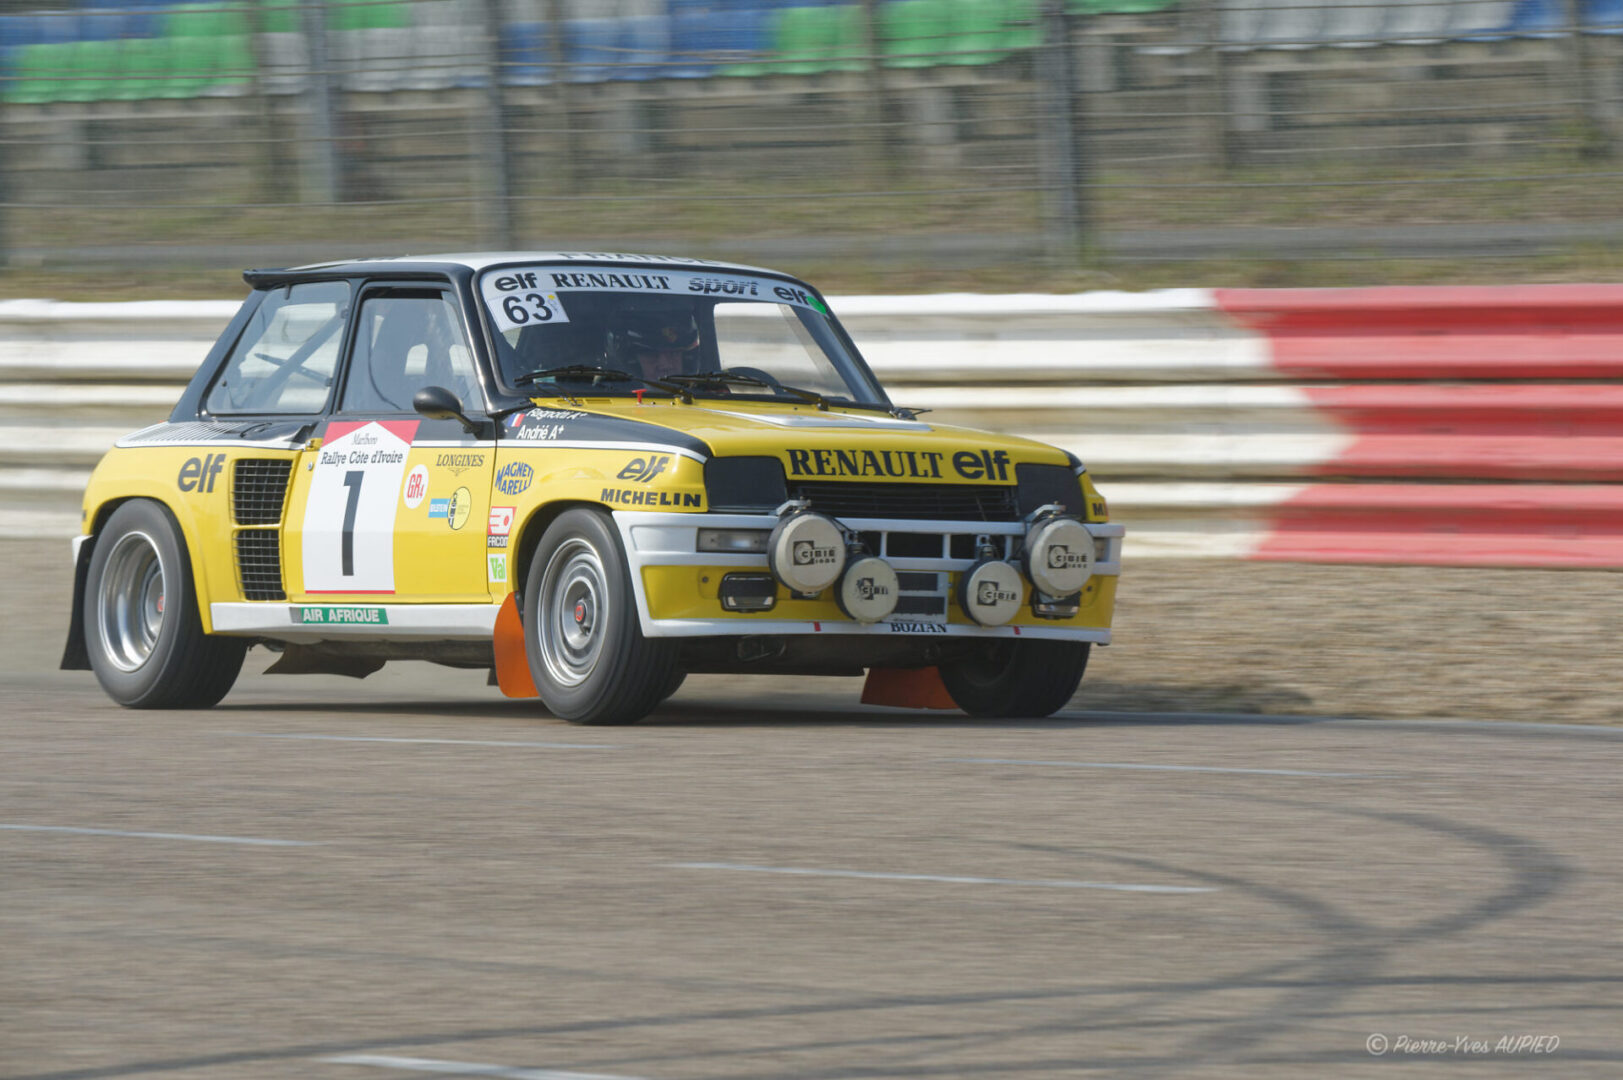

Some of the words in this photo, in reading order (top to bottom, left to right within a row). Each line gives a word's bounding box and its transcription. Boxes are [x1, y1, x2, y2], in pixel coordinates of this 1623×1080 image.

[494, 272, 538, 292] elf
[549, 272, 672, 290] RENAULT
[688, 277, 760, 296] sport
[773, 286, 809, 306] elf
[502, 293, 553, 325] 63
[320, 451, 347, 467] Rallye
[370, 449, 403, 464] d'Ivoire
[436, 454, 485, 467] LONGINES
[616, 456, 670, 483] elf
[786, 449, 943, 479] RENAULT
[952, 449, 1011, 481] elf
[177, 453, 227, 493] elf
[600, 488, 702, 508] MICHELIN
[342, 470, 365, 576] 1
[303, 608, 324, 622] AIR
[328, 608, 380, 623] AFRIQUE
